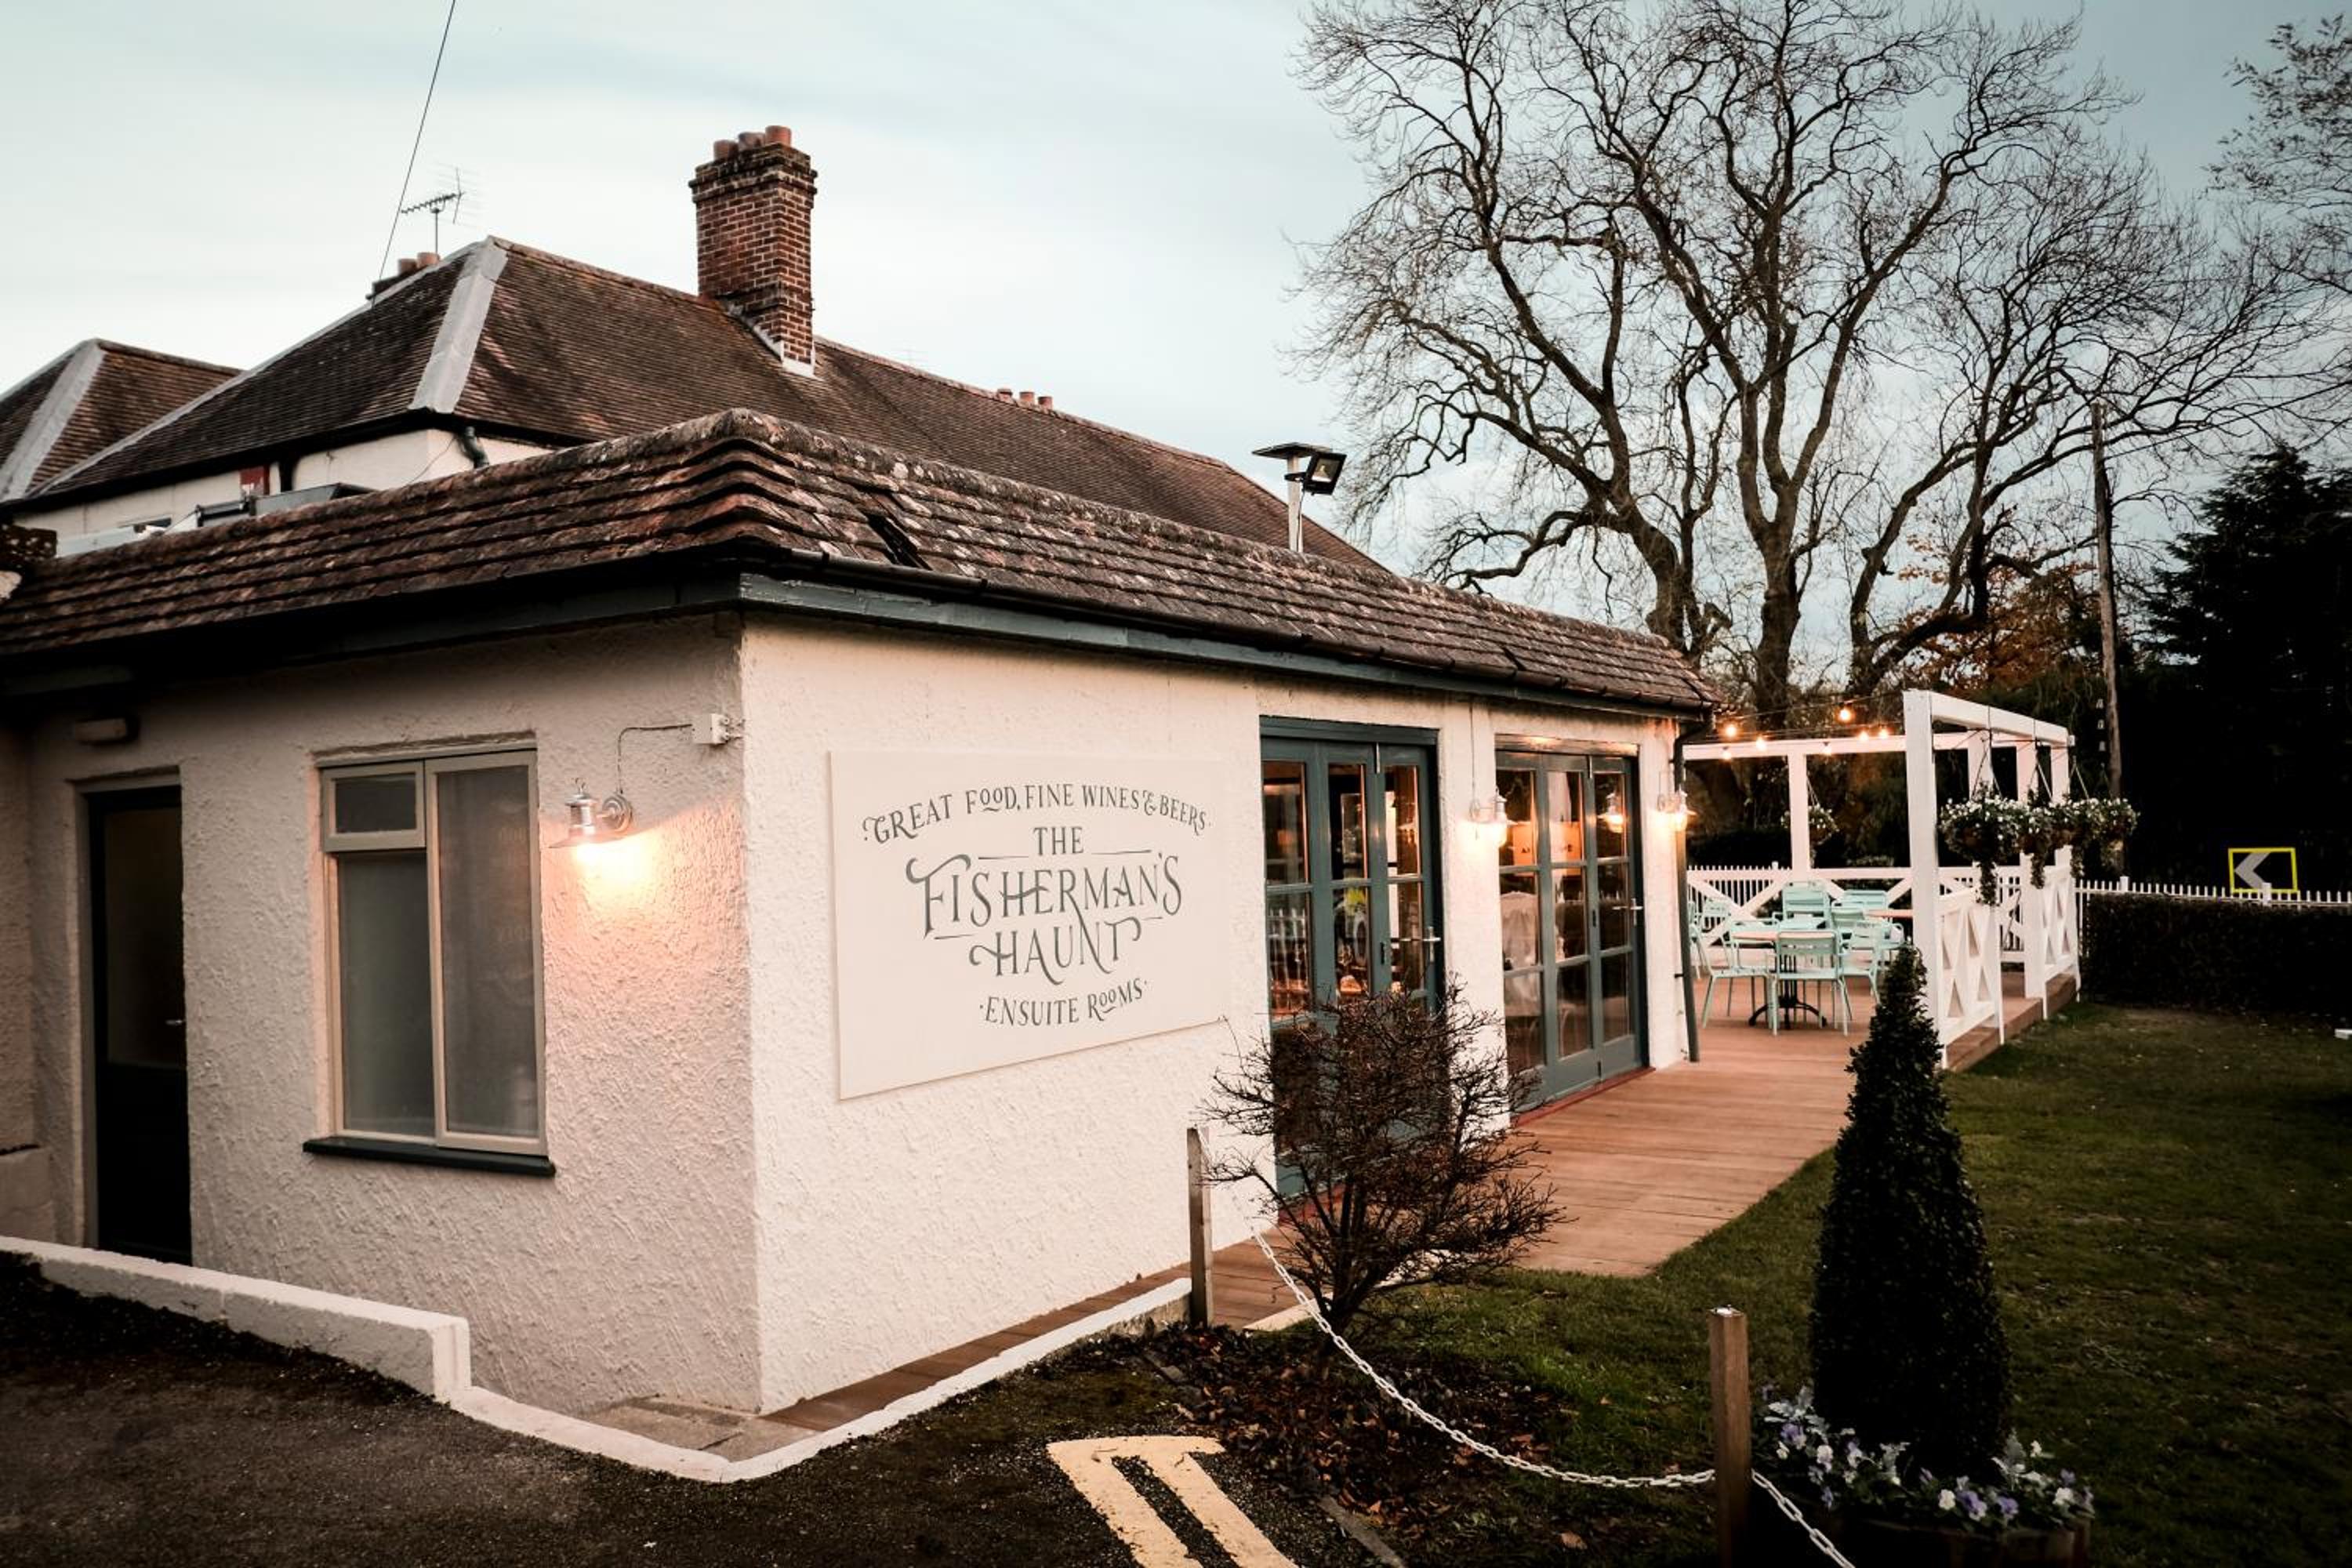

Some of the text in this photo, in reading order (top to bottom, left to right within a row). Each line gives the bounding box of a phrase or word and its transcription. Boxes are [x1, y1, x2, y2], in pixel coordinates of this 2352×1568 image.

[862, 794, 953, 844] GREAT
[1025, 784, 1074, 809] FINE
[1033, 826, 1084, 856] THE
[906, 852, 1182, 939] FISHERMAN'S
[969, 916, 1142, 985] HAUNT
[985, 978, 1143, 1026] ENSUITE ROOMS
